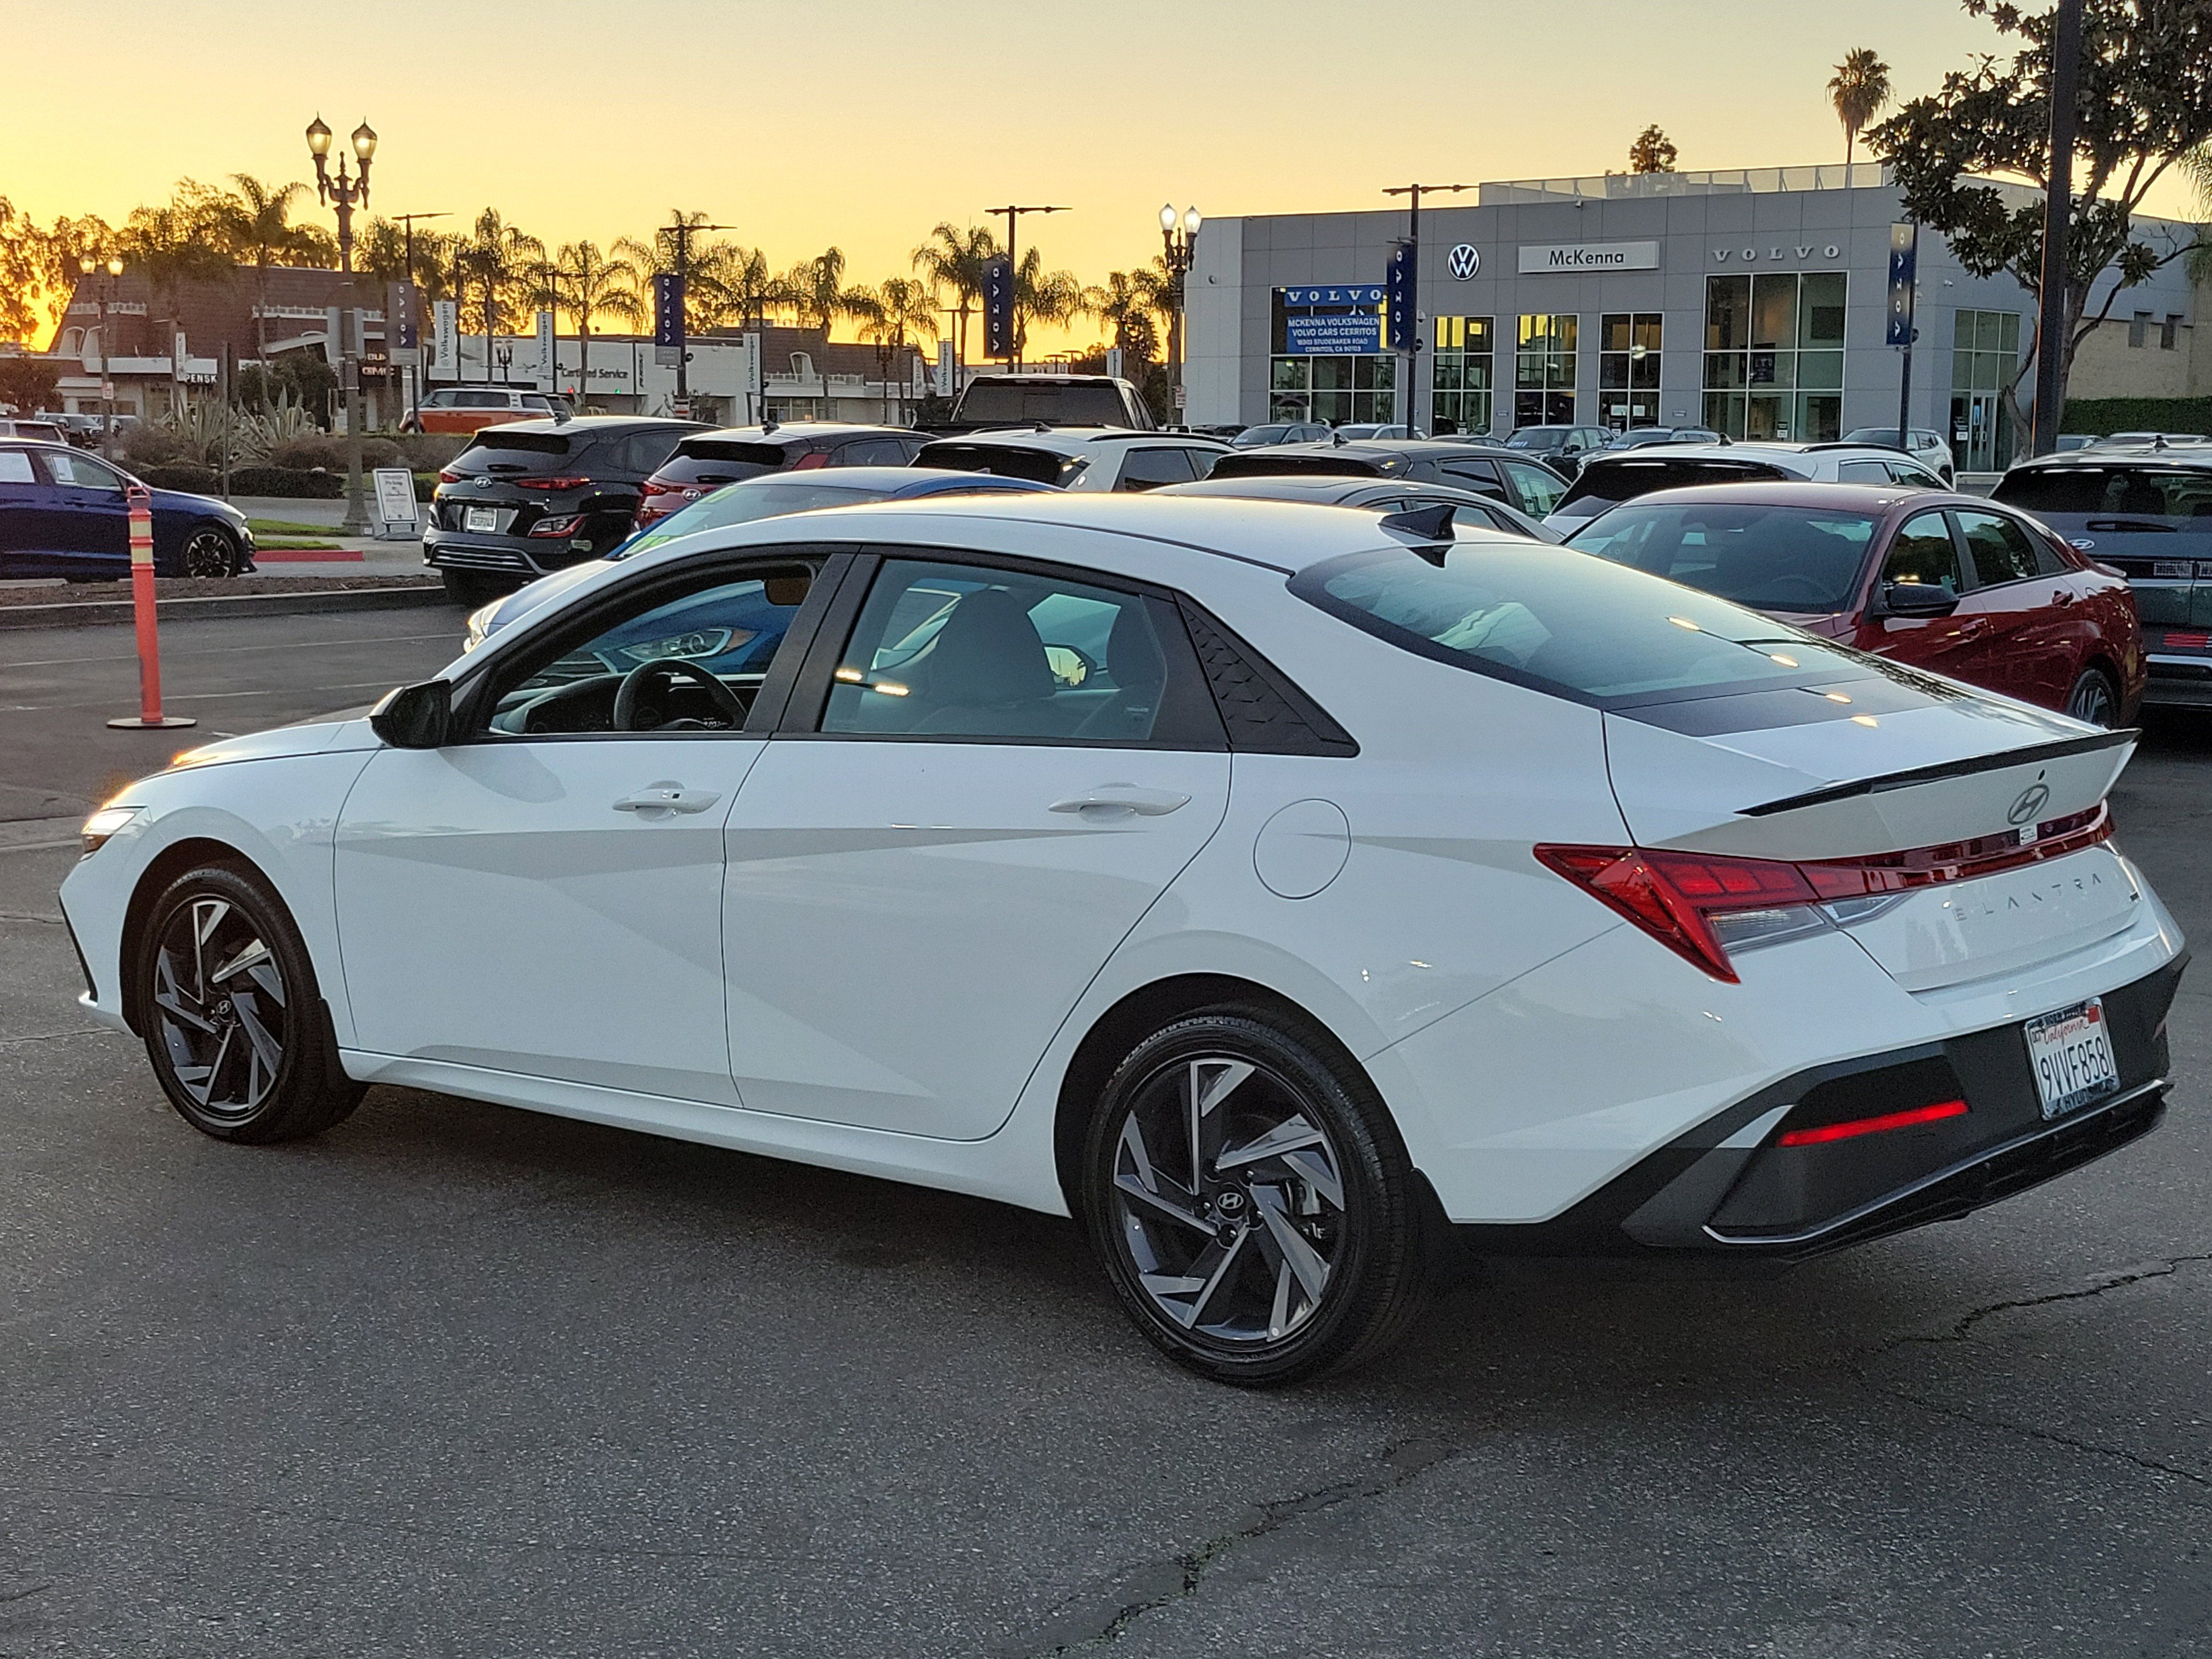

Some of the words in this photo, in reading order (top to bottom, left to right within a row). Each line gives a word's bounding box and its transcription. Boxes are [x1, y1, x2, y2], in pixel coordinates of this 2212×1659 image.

[1549, 249, 1624, 265] McKenna
[1712, 245, 1840, 262] VOLVO
[1894, 232, 1905, 338] VOLVO
[1287, 289, 1381, 302] VOLVO
[398, 286, 408, 346] VOLVO
[1288, 318, 1325, 327] MCKENNA
[1327, 317, 1379, 326] VOLKSWAGEN
[441, 303, 450, 359] Volkswagen
[1339, 328, 1377, 336] CERRITOS
[599, 369, 628, 379] Service
[1952, 873, 2101, 921] ELANTRA
[2040, 1036, 2109, 1101] 9VVF858
